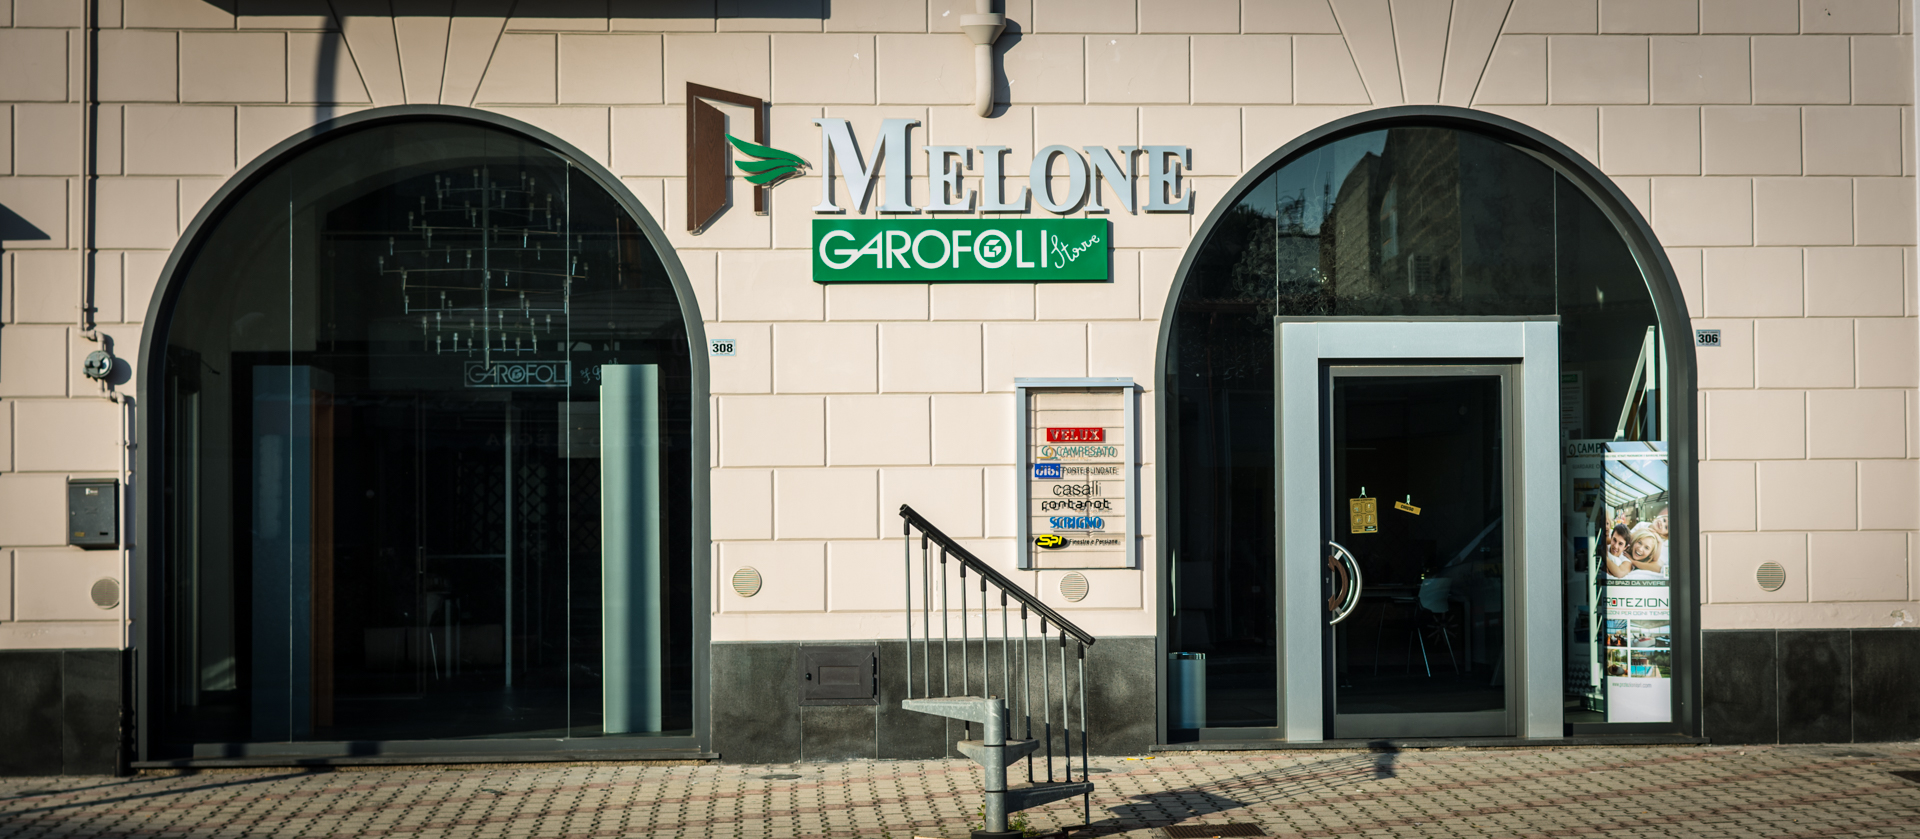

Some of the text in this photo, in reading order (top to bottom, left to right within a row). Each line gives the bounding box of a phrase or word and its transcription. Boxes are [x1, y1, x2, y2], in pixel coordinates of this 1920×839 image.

[811, 117, 1193, 215] MELONE
[818, 229, 1048, 269] GAROFOLI
[1698, 333, 1719, 343] 306
[712, 343, 733, 353] 308
[1049, 429, 1100, 441] VELUX
[1056, 445, 1116, 458] CAMPESATO
[1577, 442, 1602, 454] CAMP
[1035, 466, 1060, 476] dibi
[1052, 480, 1099, 496] casali
[1041, 499, 1110, 511] fontanot
[1049, 516, 1103, 529] SCRIGNO
[1037, 534, 1063, 547] SPI
